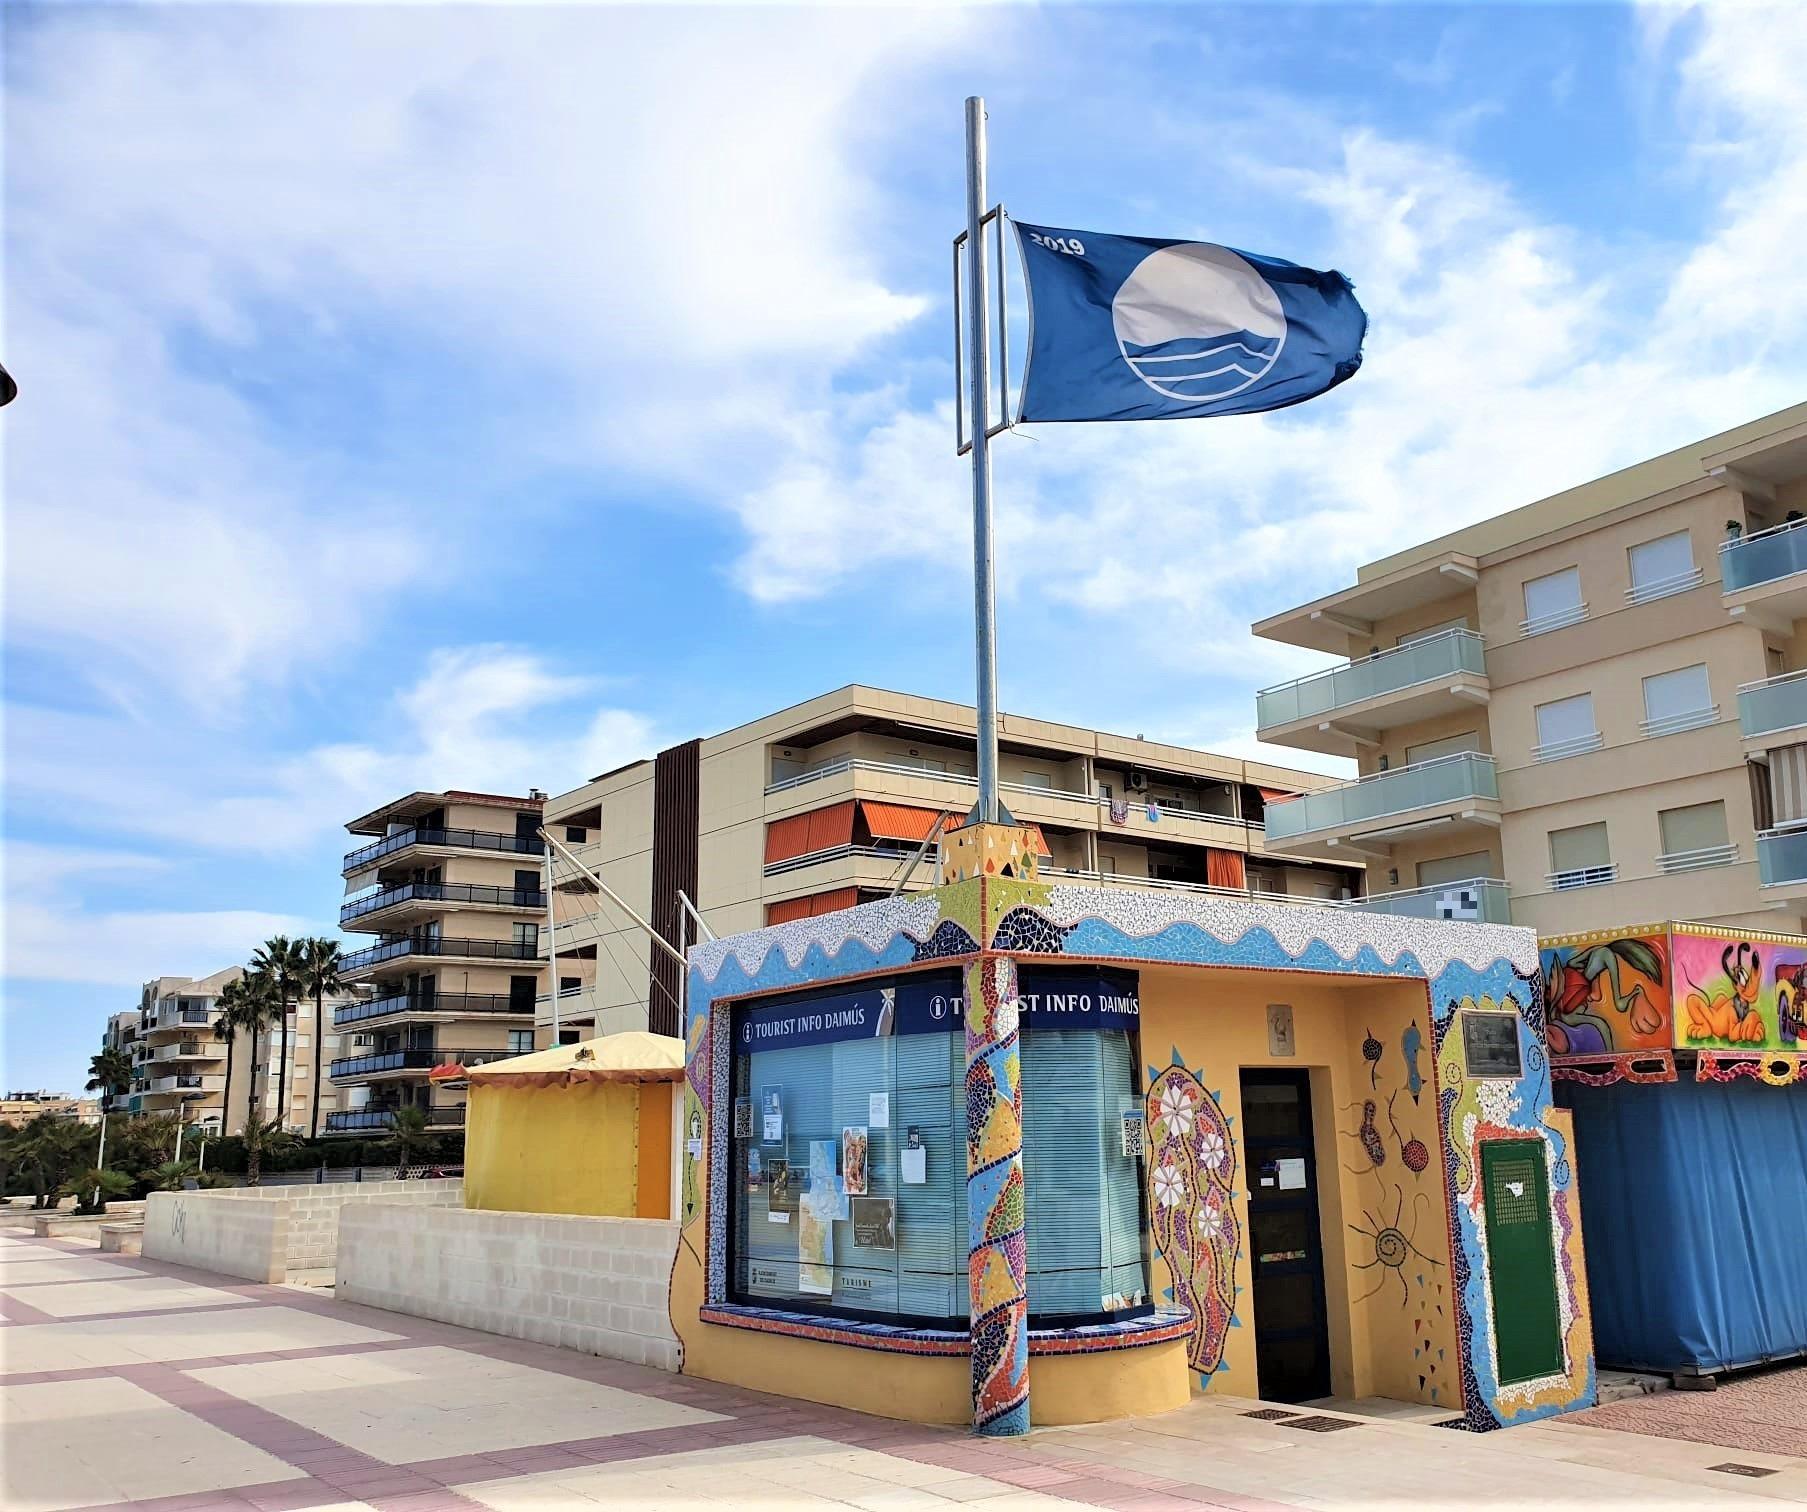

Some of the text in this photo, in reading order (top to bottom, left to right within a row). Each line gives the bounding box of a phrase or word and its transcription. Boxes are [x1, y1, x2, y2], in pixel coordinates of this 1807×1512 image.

[1029, 233, 1085, 256] 2019
[1046, 994, 1091, 1012] INFO
[1099, 992, 1139, 1015] DAIMÚS
[755, 1003, 865, 1039] TOURIST INFO DAIMÚS
